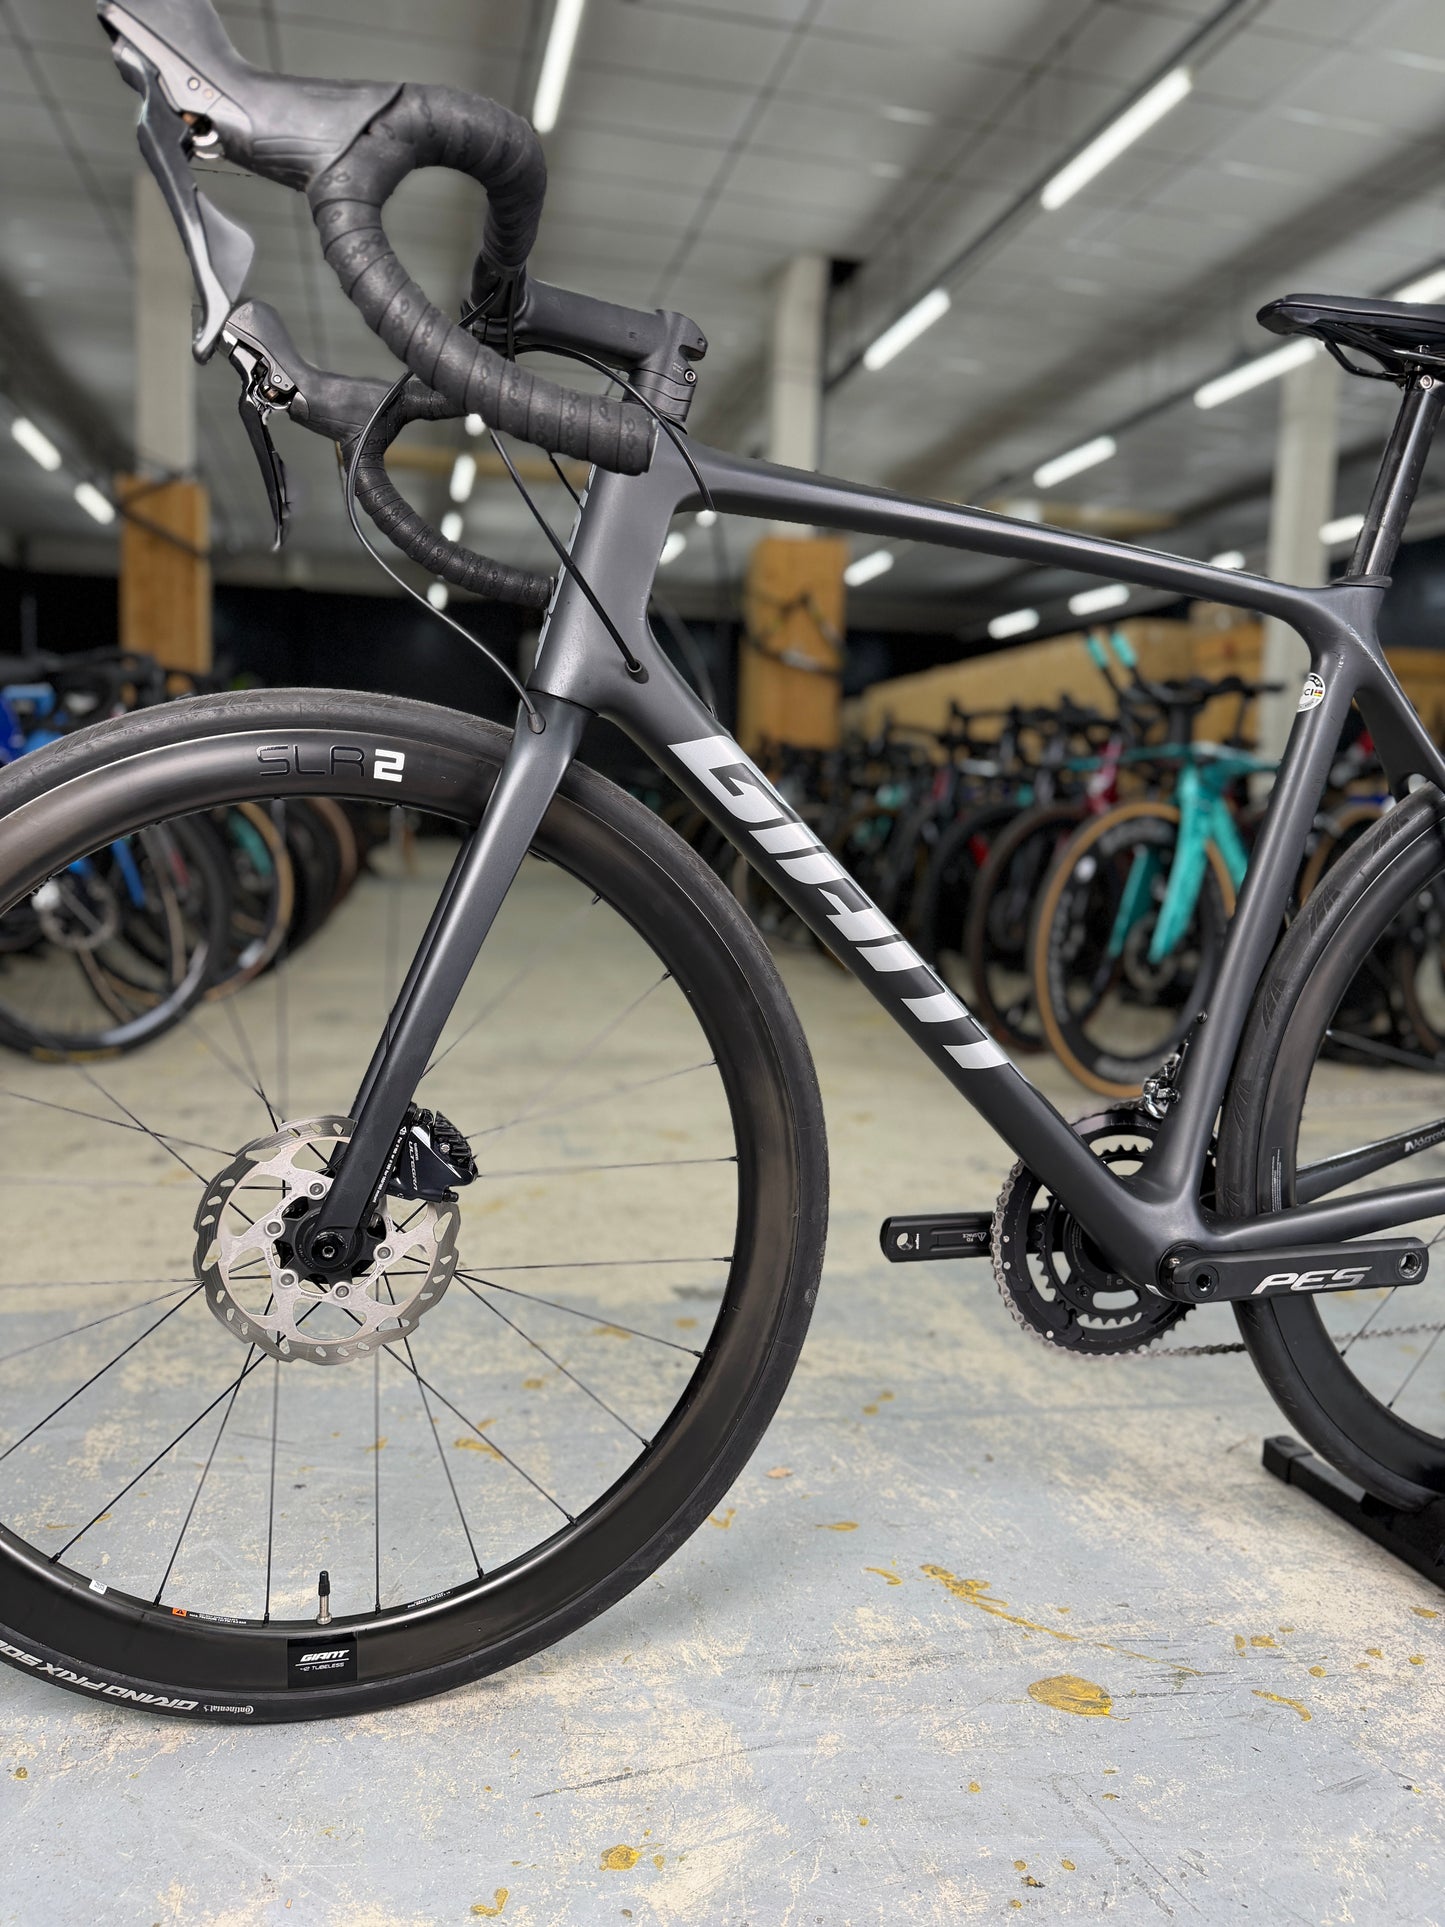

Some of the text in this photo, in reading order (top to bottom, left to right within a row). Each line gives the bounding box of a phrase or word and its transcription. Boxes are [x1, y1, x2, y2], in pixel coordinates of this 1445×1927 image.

[256, 744, 405, 783] SLR 2
[667, 735, 1010, 1069] GIANT
[408, 1140, 418, 1191] ULTEGRA
[1251, 1266, 1372, 1295] PES
[300, 1649, 350, 1662] GIANT
[312, 1662, 345, 1671] TUBELESS
[38, 1662, 107, 1691] PRIX
[102, 1685, 200, 1711] GRAND
[210, 1704, 254, 1715] Continental
